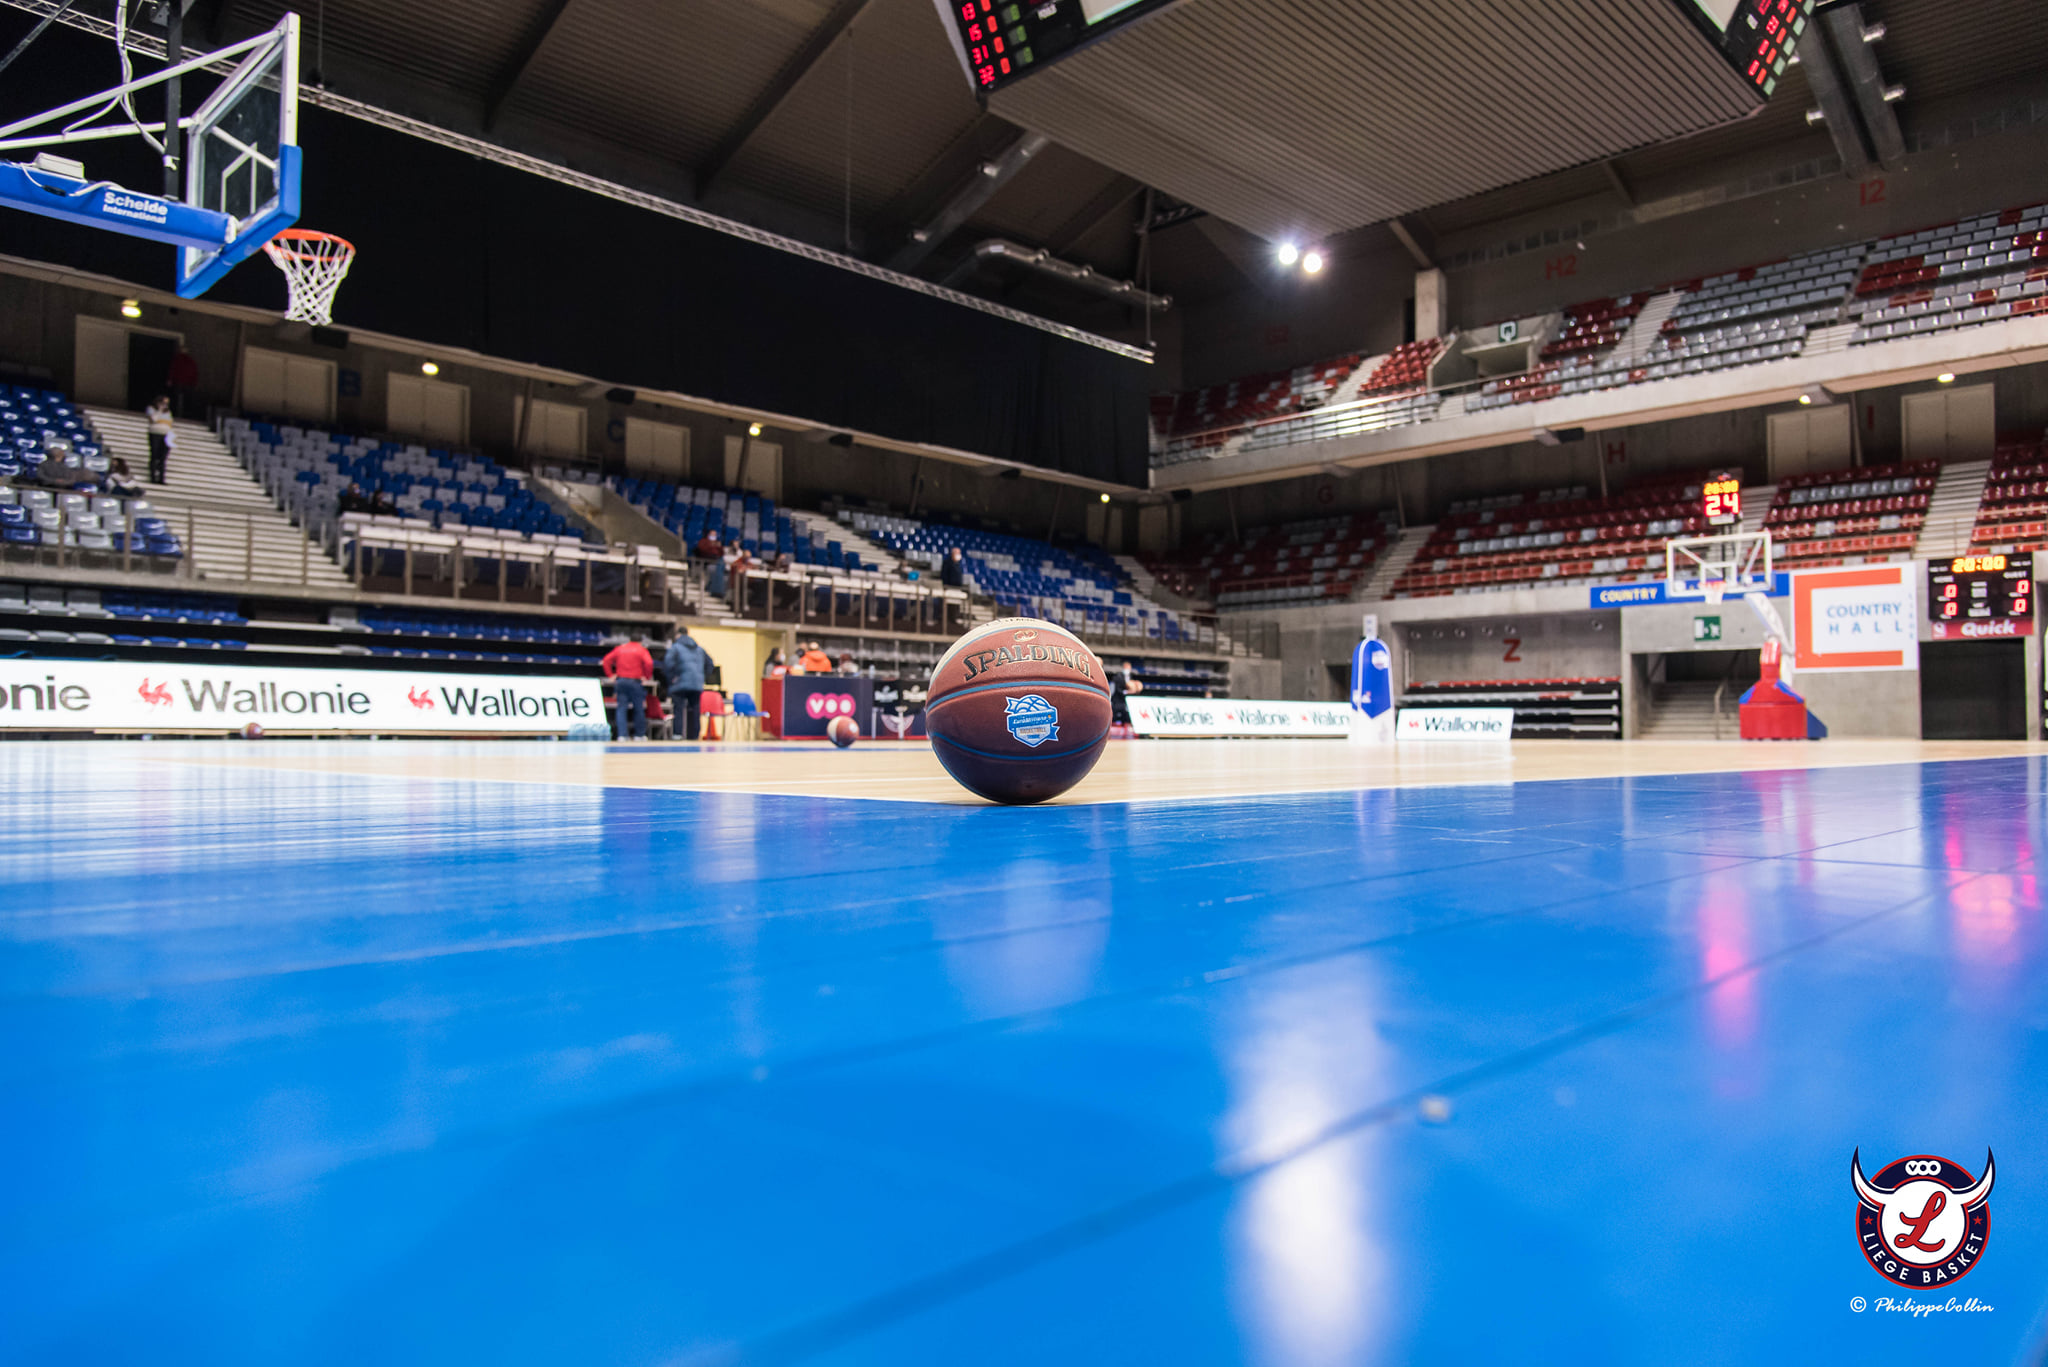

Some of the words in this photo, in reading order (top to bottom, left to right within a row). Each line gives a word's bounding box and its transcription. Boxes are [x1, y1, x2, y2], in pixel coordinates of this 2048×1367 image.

[104, 191, 168, 216] Schelde
[103, 204, 167, 224] International
[1545, 254, 1578, 280] H2
[1608, 442, 1625, 463] H
[1705, 492, 1740, 517] 24
[1952, 555, 2006, 574] 20:00
[1600, 587, 1658, 603] COUNTRY
[1944, 584, 1958, 598] 0
[2017, 579, 2030, 594] 0
[1826, 602, 1902, 618] COUNTRY
[1944, 602, 1958, 616] 0
[2014, 598, 2027, 613] 0
[1961, 620, 2016, 637] Quick
[1503, 638, 1521, 663] Z
[963, 644, 1091, 681] SPALDING
[182, 679, 371, 714] Wallonie
[440, 687, 590, 718] Wallonie
[1151, 706, 1214, 726] Wallonie
[1236, 708, 1291, 727] Wallonie
[1425, 716, 1502, 733] Wallonie
